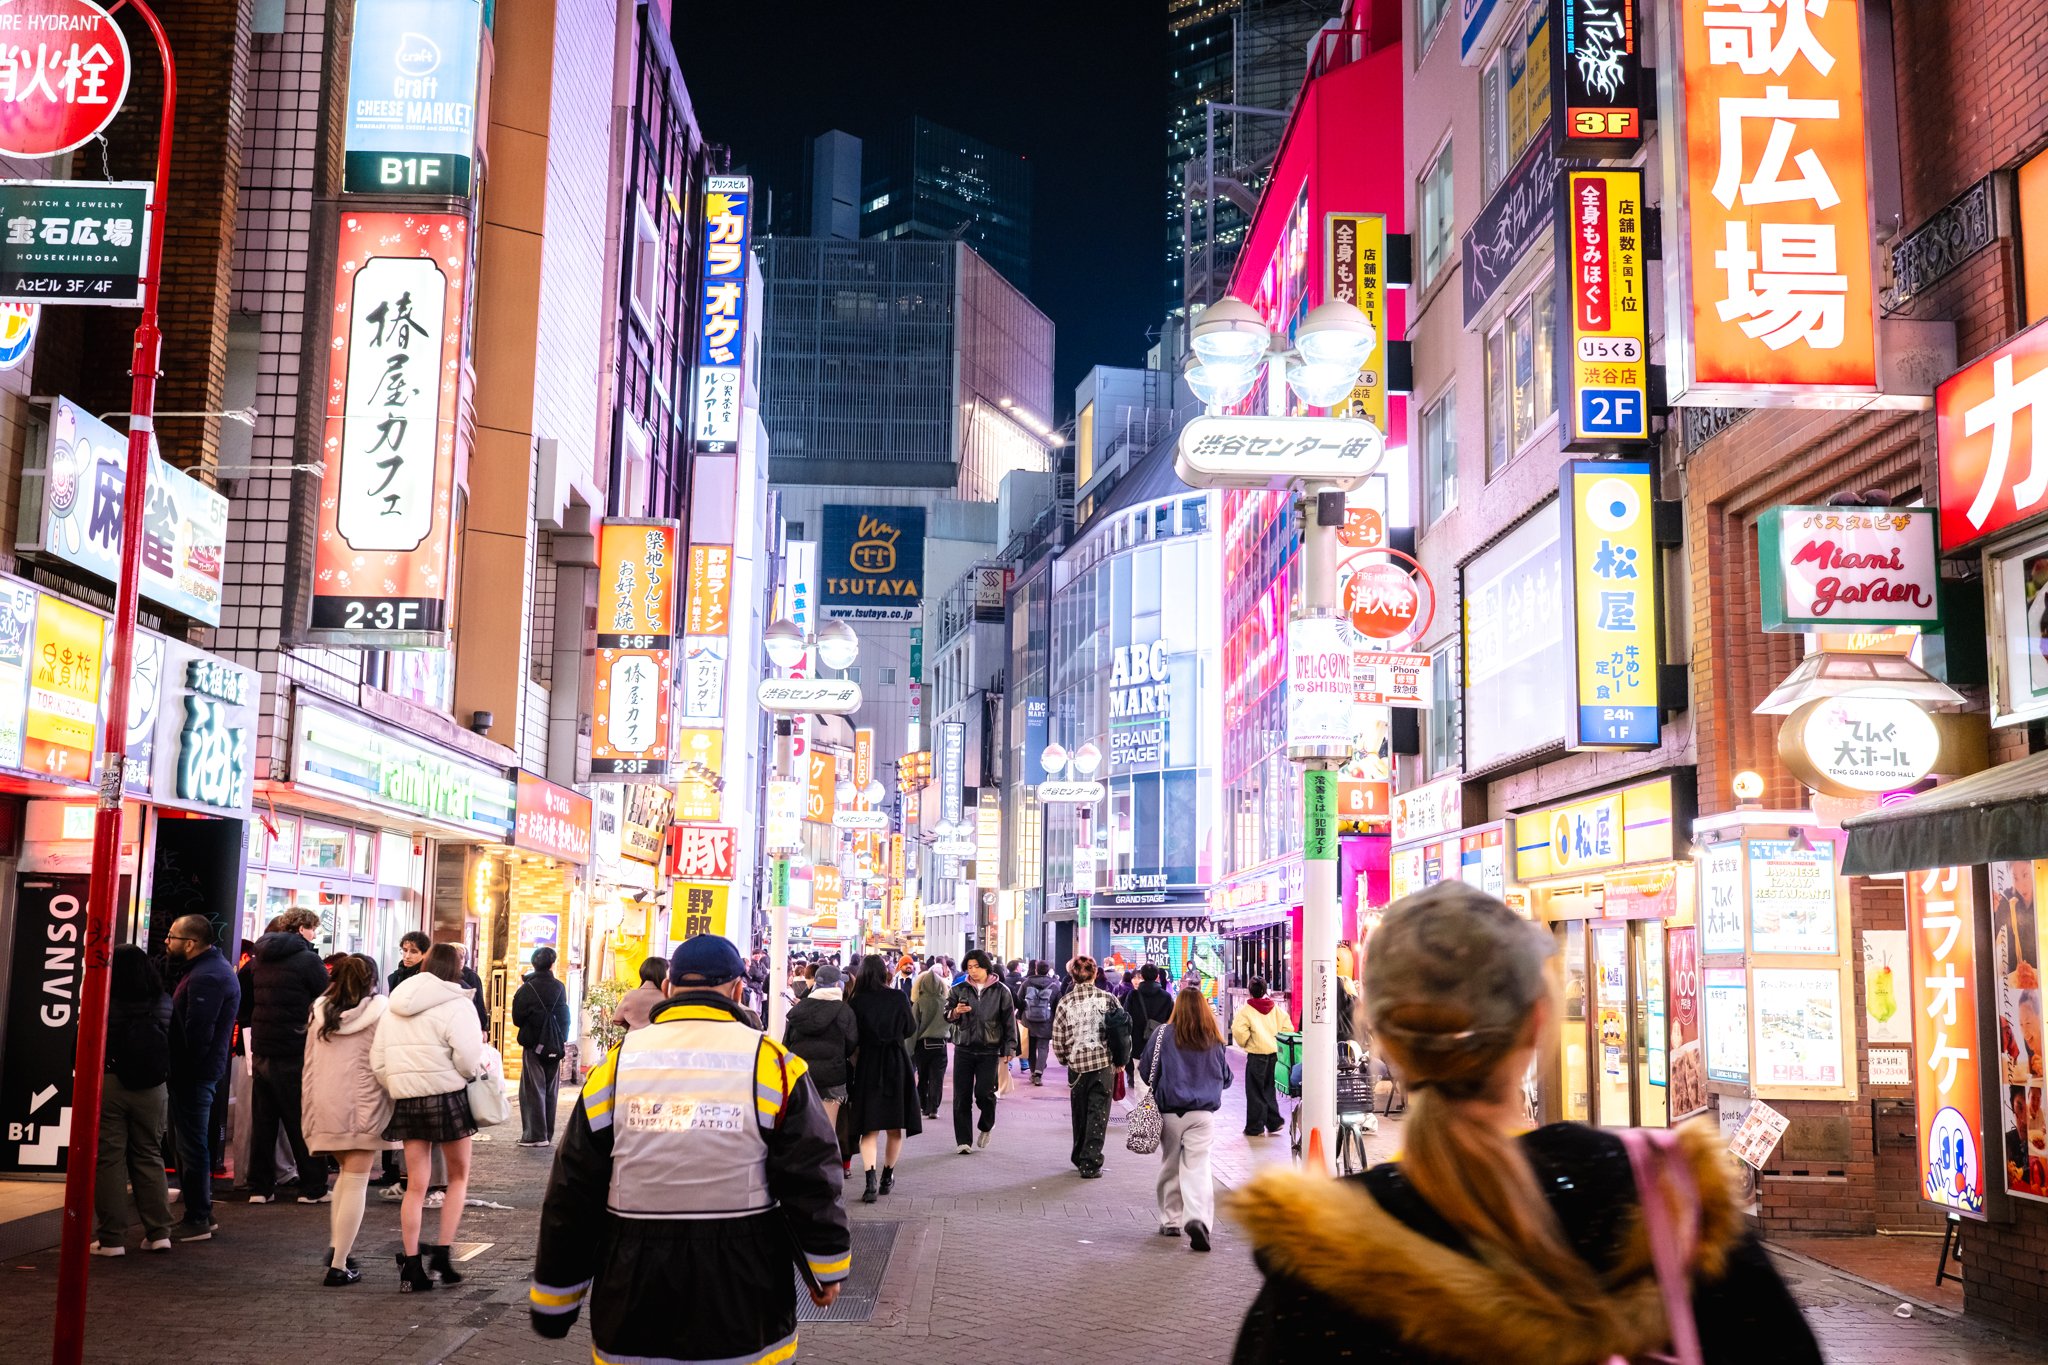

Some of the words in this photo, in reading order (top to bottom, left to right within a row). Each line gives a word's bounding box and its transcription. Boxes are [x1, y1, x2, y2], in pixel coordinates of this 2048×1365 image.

[0, 14, 22, 31] IRE
[28, 14, 101, 31] HYDRANT
[0, 43, 114, 104] 消火栓
[393, 77, 438, 99] Craft
[357, 100, 404, 117] CHEESE
[406, 101, 473, 127] MARKET
[1575, 112, 1630, 134] 3F
[380, 158, 441, 186] B1F
[1703, 0, 1851, 351] 歌広場
[711, 180, 746, 190] プリンスビル
[76, 201, 124, 209] JEWELRY
[6, 216, 133, 247] 宝石広場
[17, 254, 118, 262] HOUSEKIHIROBA
[1580, 185, 1602, 325] 全身もみほぐし
[1618, 200, 1638, 312] 店舗数全国1位
[16, 278, 61, 292] A2ビル
[704, 211, 744, 349] カラオケ
[1363, 249, 1377, 330] 店舗数全国1
[1582, 341, 1636, 358] りらくる
[1584, 367, 1637, 385] 渋谷店
[365, 291, 429, 517] 椿屋カフェ
[702, 372, 718, 437] ルノアール
[1590, 397, 1634, 426] 2F
[708, 441, 725, 452] 2F
[1192, 434, 1373, 459] 渋谷センター街
[210, 498, 227, 526] 5F
[1803, 513, 1912, 531] パスタとピザ
[1791, 539, 1905, 571] Miami
[644, 531, 665, 632] 築地もんじゃ
[706, 548, 728, 633] 野郎ラーメン
[826, 578, 918, 596] TSUTAYA
[1592, 539, 1639, 632] 松屋
[15, 591, 33, 614] 5F
[613, 561, 636, 631] お好み焼
[1349, 584, 1414, 619] 消火栓
[829, 608, 913, 620] www.tsutaya.co.jp
[39, 642, 91, 693] 鳥貴族
[1110, 639, 1169, 687] ABC
[1295, 653, 1351, 680] WELCOME
[1390, 665, 1420, 675] iPhone
[1611, 652, 1624, 694] カレー
[1625, 645, 1640, 688] 牛めし
[1396, 675, 1416, 685] 修理
[1595, 661, 1611, 700] 定食
[623, 662, 647, 746] 椿屋カフェ
[762, 687, 855, 701] 渋谷センター街
[1028, 702, 1046, 711] ABC
[1109, 683, 1170, 718] MART
[1604, 709, 1635, 721] 24h
[1110, 729, 1163, 748] GRAND
[1844, 720, 1898, 744] てんぐ
[46, 749, 67, 772] 4F
[1110, 748, 1160, 765] STAGE
[1834, 740, 1912, 768] 大ホール
[1828, 767, 1847, 776] TENG
[1847, 768, 1873, 777] GRAND
[1874, 769, 1895, 778] FOOD
[1897, 770, 1916, 779] HALL
[379, 755, 474, 821] FamilyMart
[1350, 789, 1374, 810] B1
[1315, 775, 1327, 855] 落書きは犯罪です
[1575, 806, 1611, 859] 松屋
[677, 828, 729, 875] 豚
[1113, 874, 1168, 891] ABC-MART
[1764, 866, 1821, 878] JAPANESE
[1770, 877, 1815, 889] IZAKAYA
[1115, 895, 1141, 904] GRAND
[1141, 894, 1165, 903] STAGE
[1711, 885, 1734, 908] てんぐ
[1754, 888, 1832, 900] RESTAURANT!
[685, 888, 713, 940] 野郎
[1113, 918, 1175, 935] SHIBUYA
[1707, 907, 1741, 935] 大ホール
[1146, 937, 1168, 953] ABC
[40, 893, 80, 1028] GANSO
[1675, 969, 1696, 997] 100
[691, 1119, 742, 1129] PATROL
[1721, 1111, 1735, 1122] Diced
[8, 1122, 35, 1142] B1
